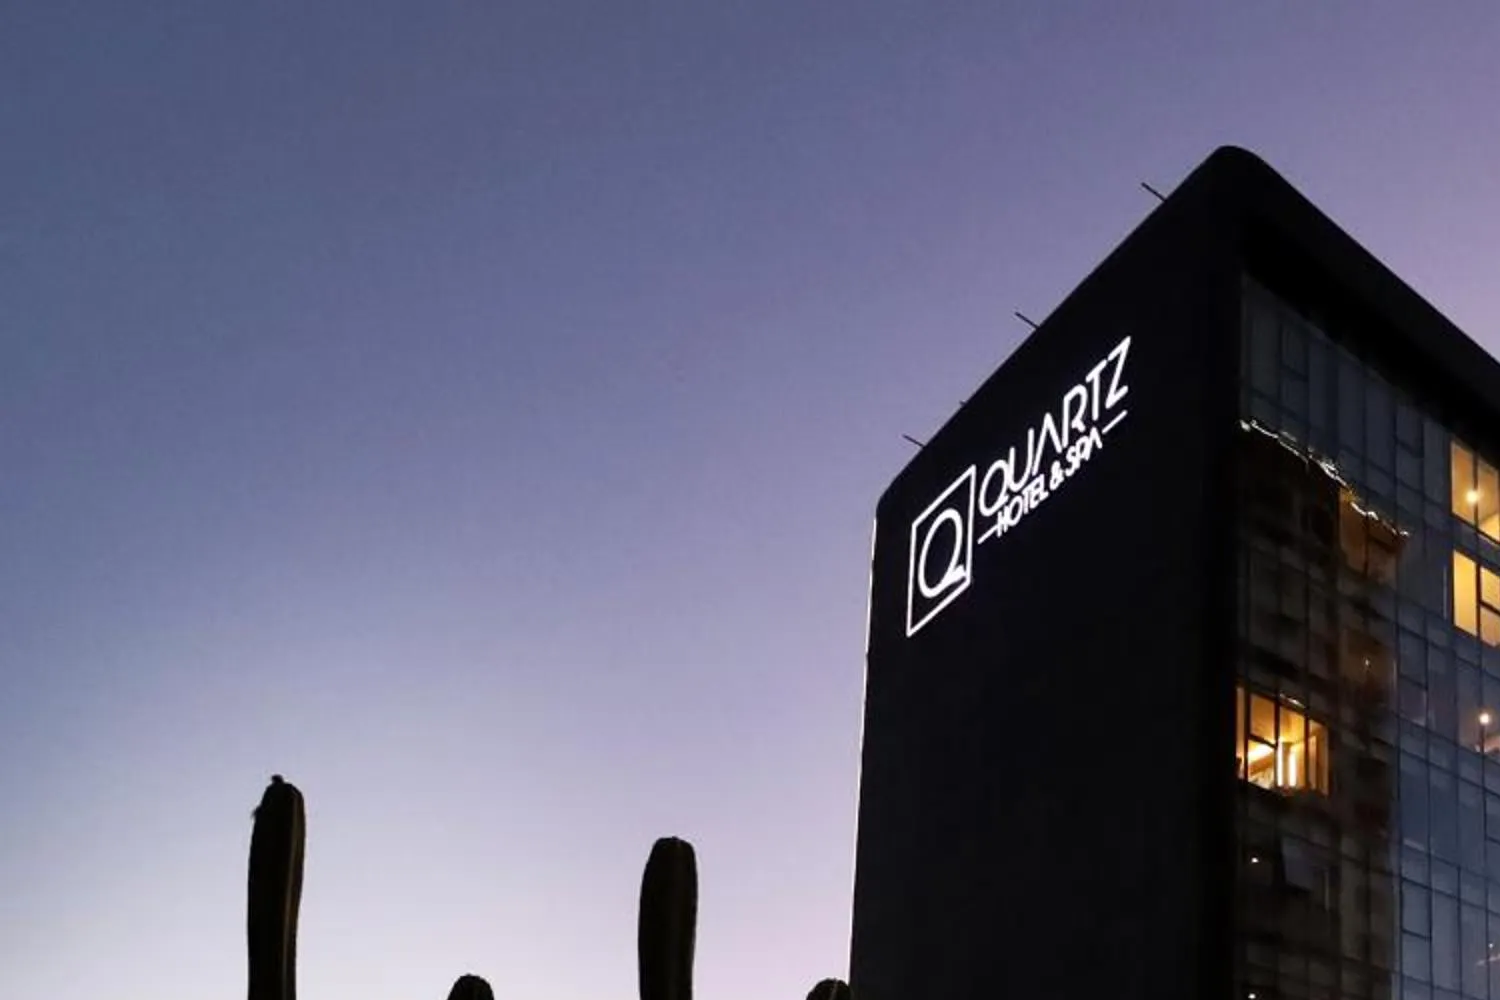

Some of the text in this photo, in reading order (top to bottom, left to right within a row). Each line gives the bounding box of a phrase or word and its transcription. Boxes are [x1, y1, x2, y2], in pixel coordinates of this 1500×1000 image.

[979, 336, 1131, 517] QUARTZ
[997, 426, 1102, 536] HOTEL & SPA
[918, 508, 966, 597] Q
